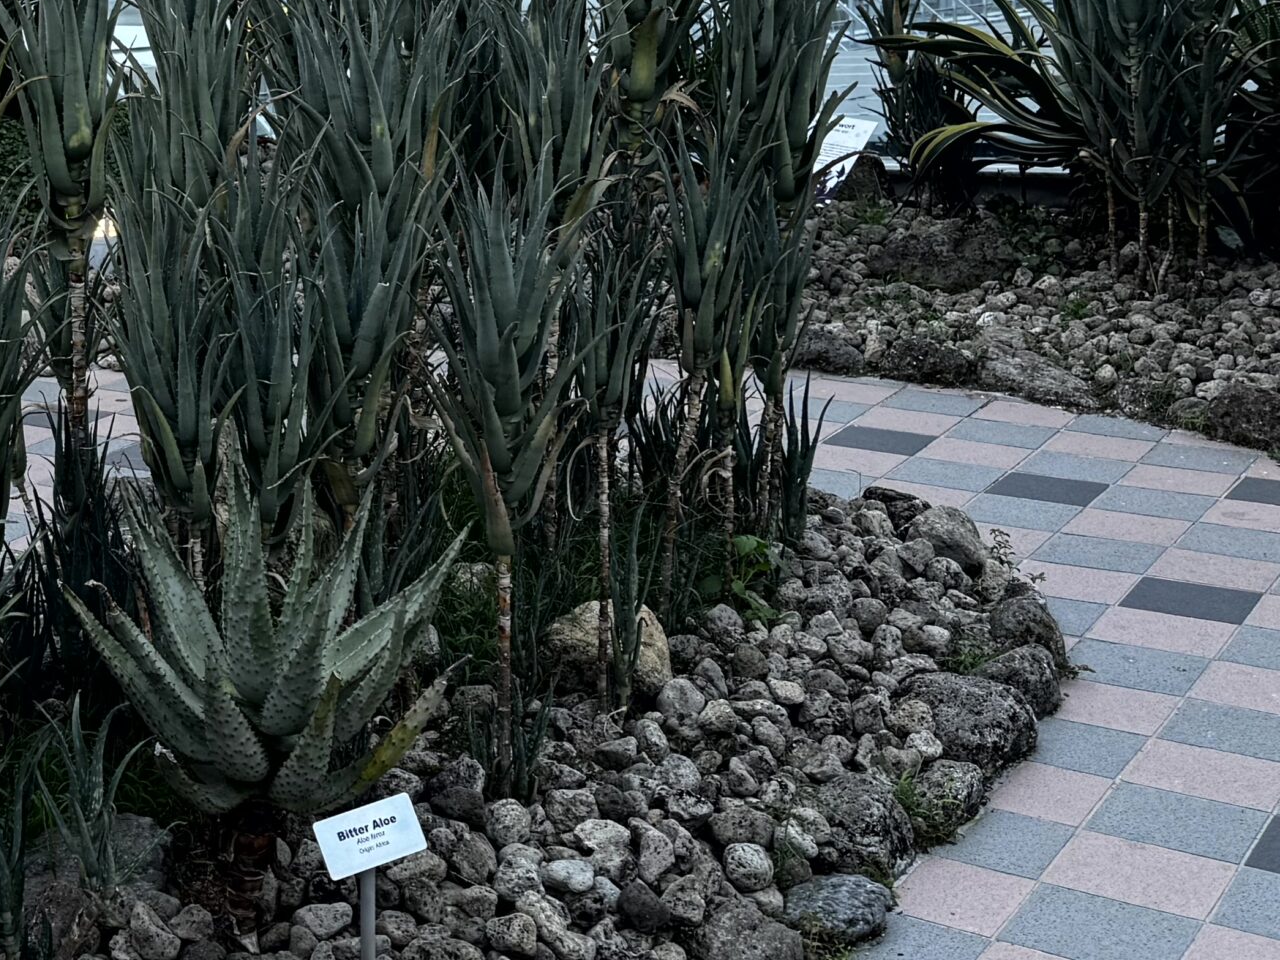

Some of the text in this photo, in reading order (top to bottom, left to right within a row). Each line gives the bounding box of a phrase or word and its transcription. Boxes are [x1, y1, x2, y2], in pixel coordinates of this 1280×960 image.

[336, 815, 397, 841] Bitter Aloe
[356, 835, 370, 845] Aloe
